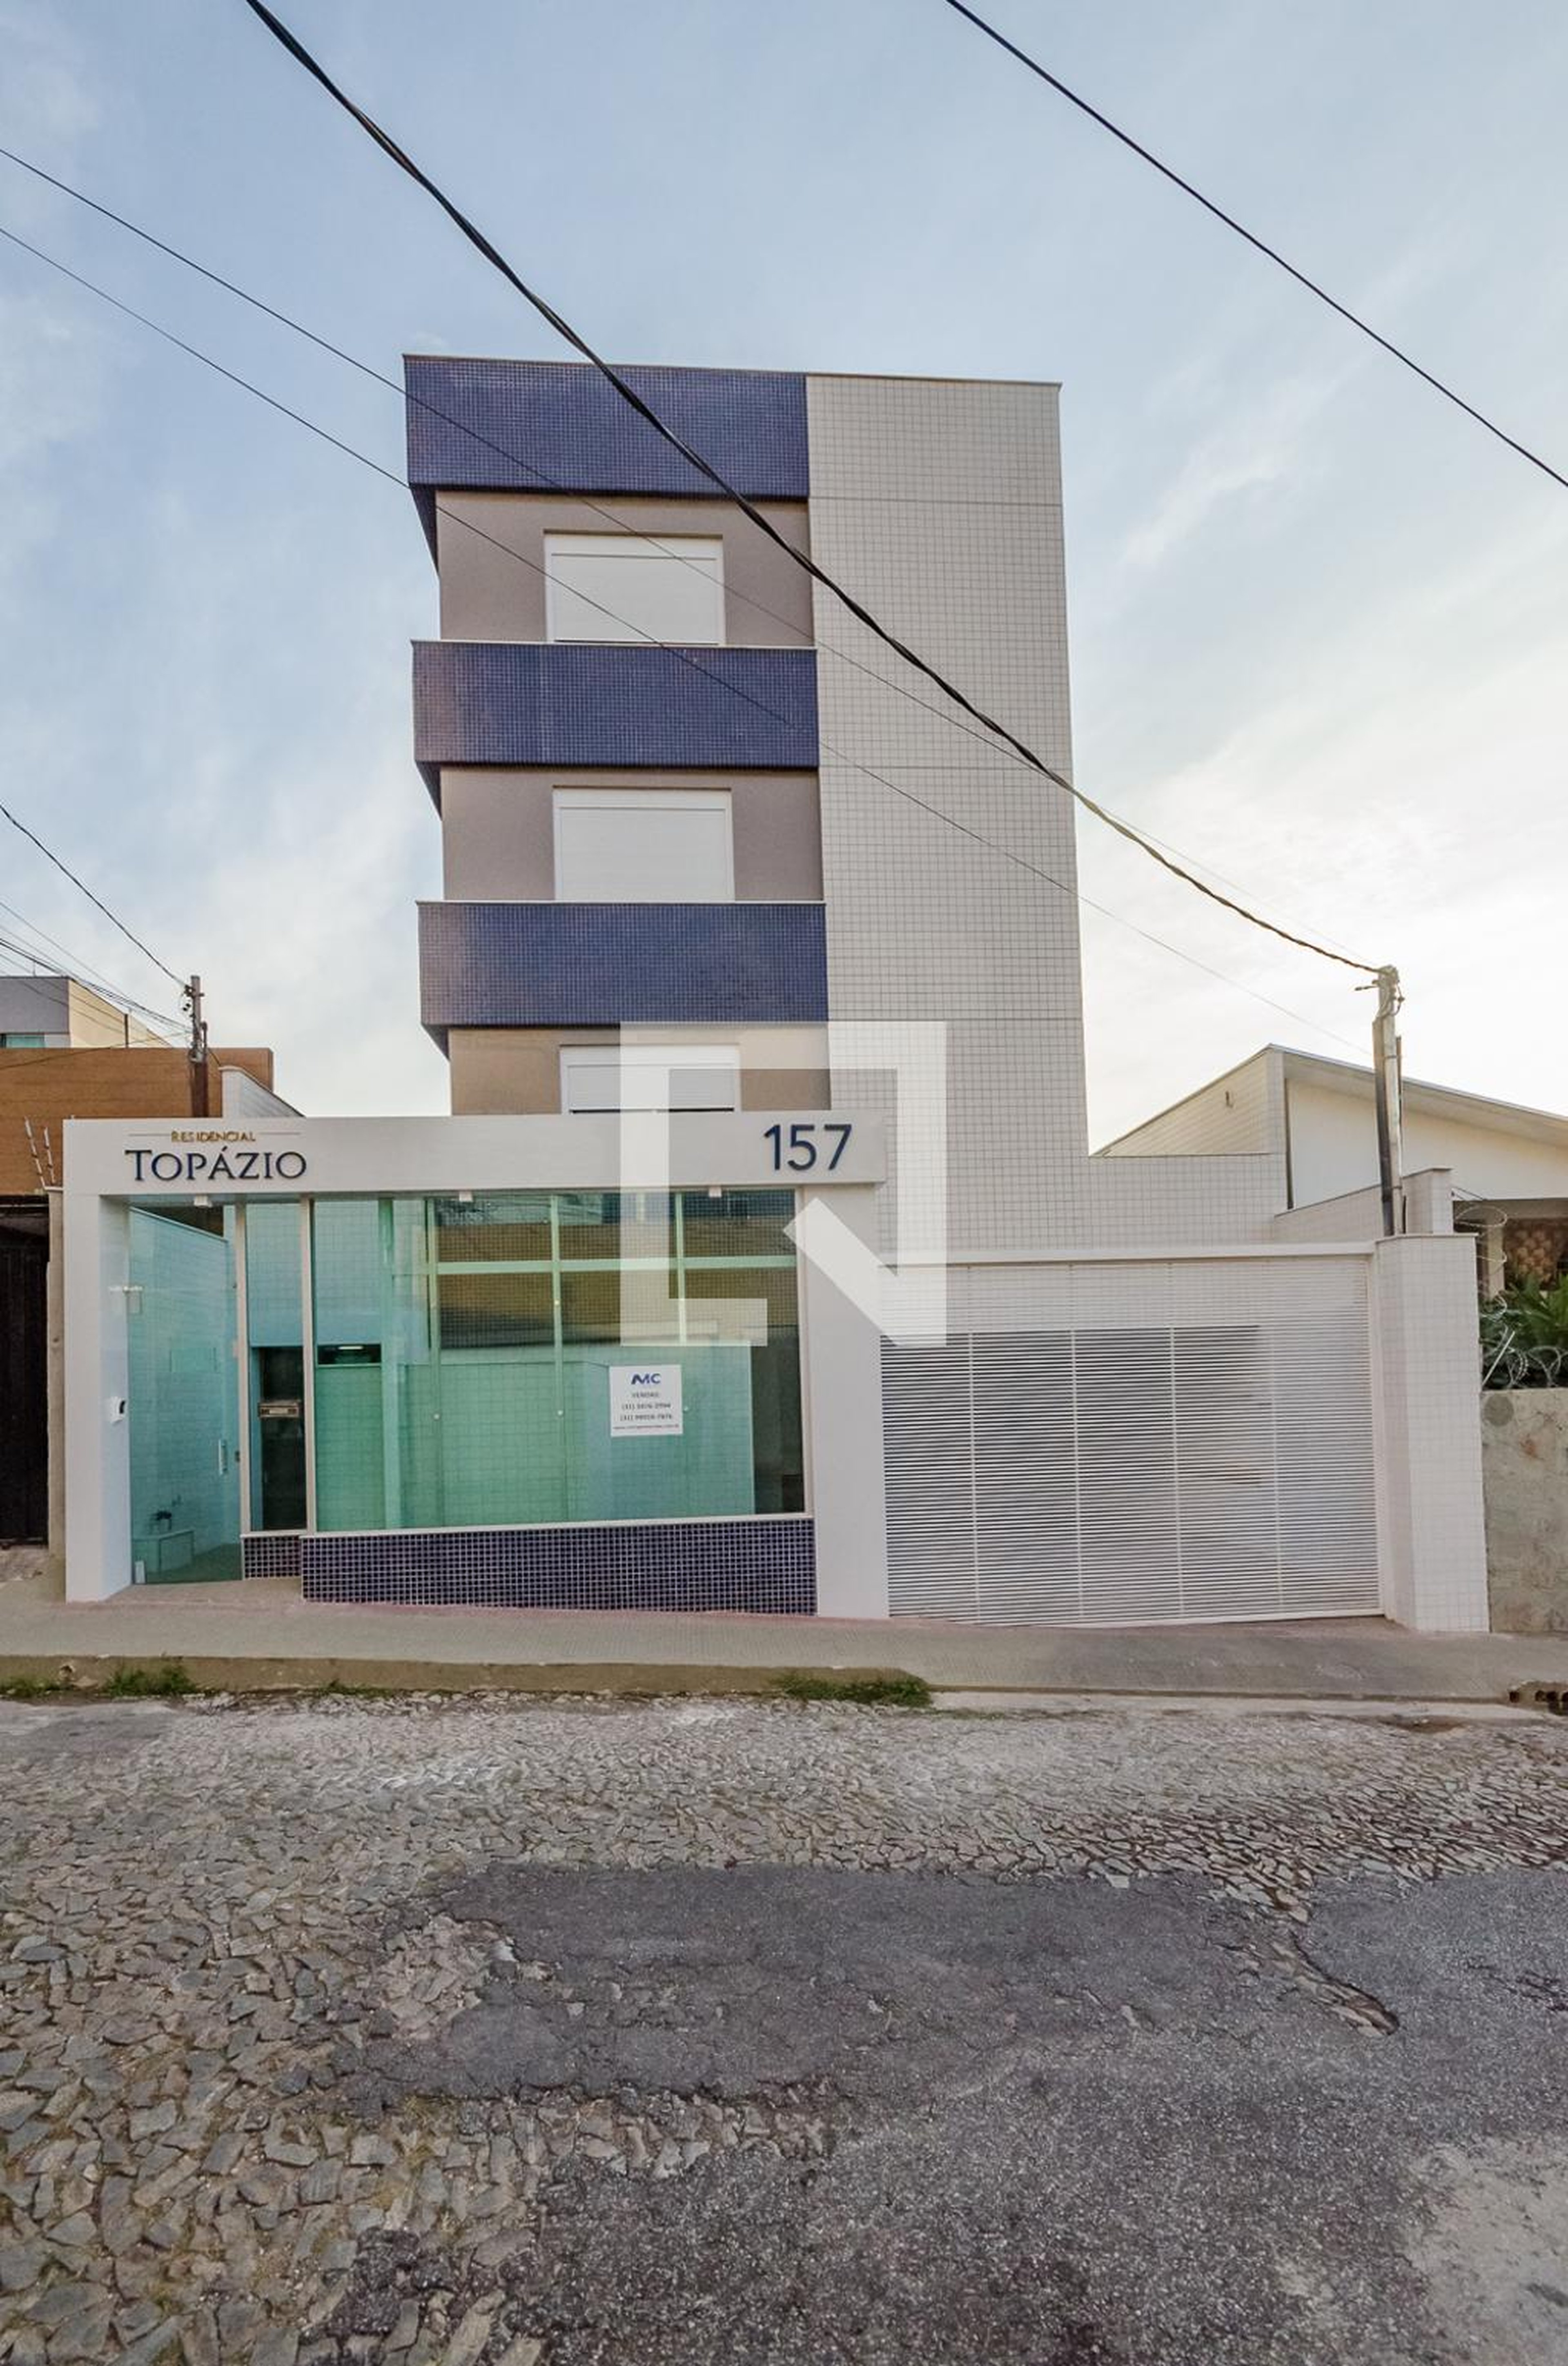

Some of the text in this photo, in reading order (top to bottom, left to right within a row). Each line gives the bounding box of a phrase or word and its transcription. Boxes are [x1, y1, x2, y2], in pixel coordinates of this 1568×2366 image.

[171, 1130, 256, 1143] RESIDENCIAL
[764, 1124, 852, 1170] 157
[125, 1146, 307, 1181] TOPÁZIO
[631, 1373, 661, 1384] MC
